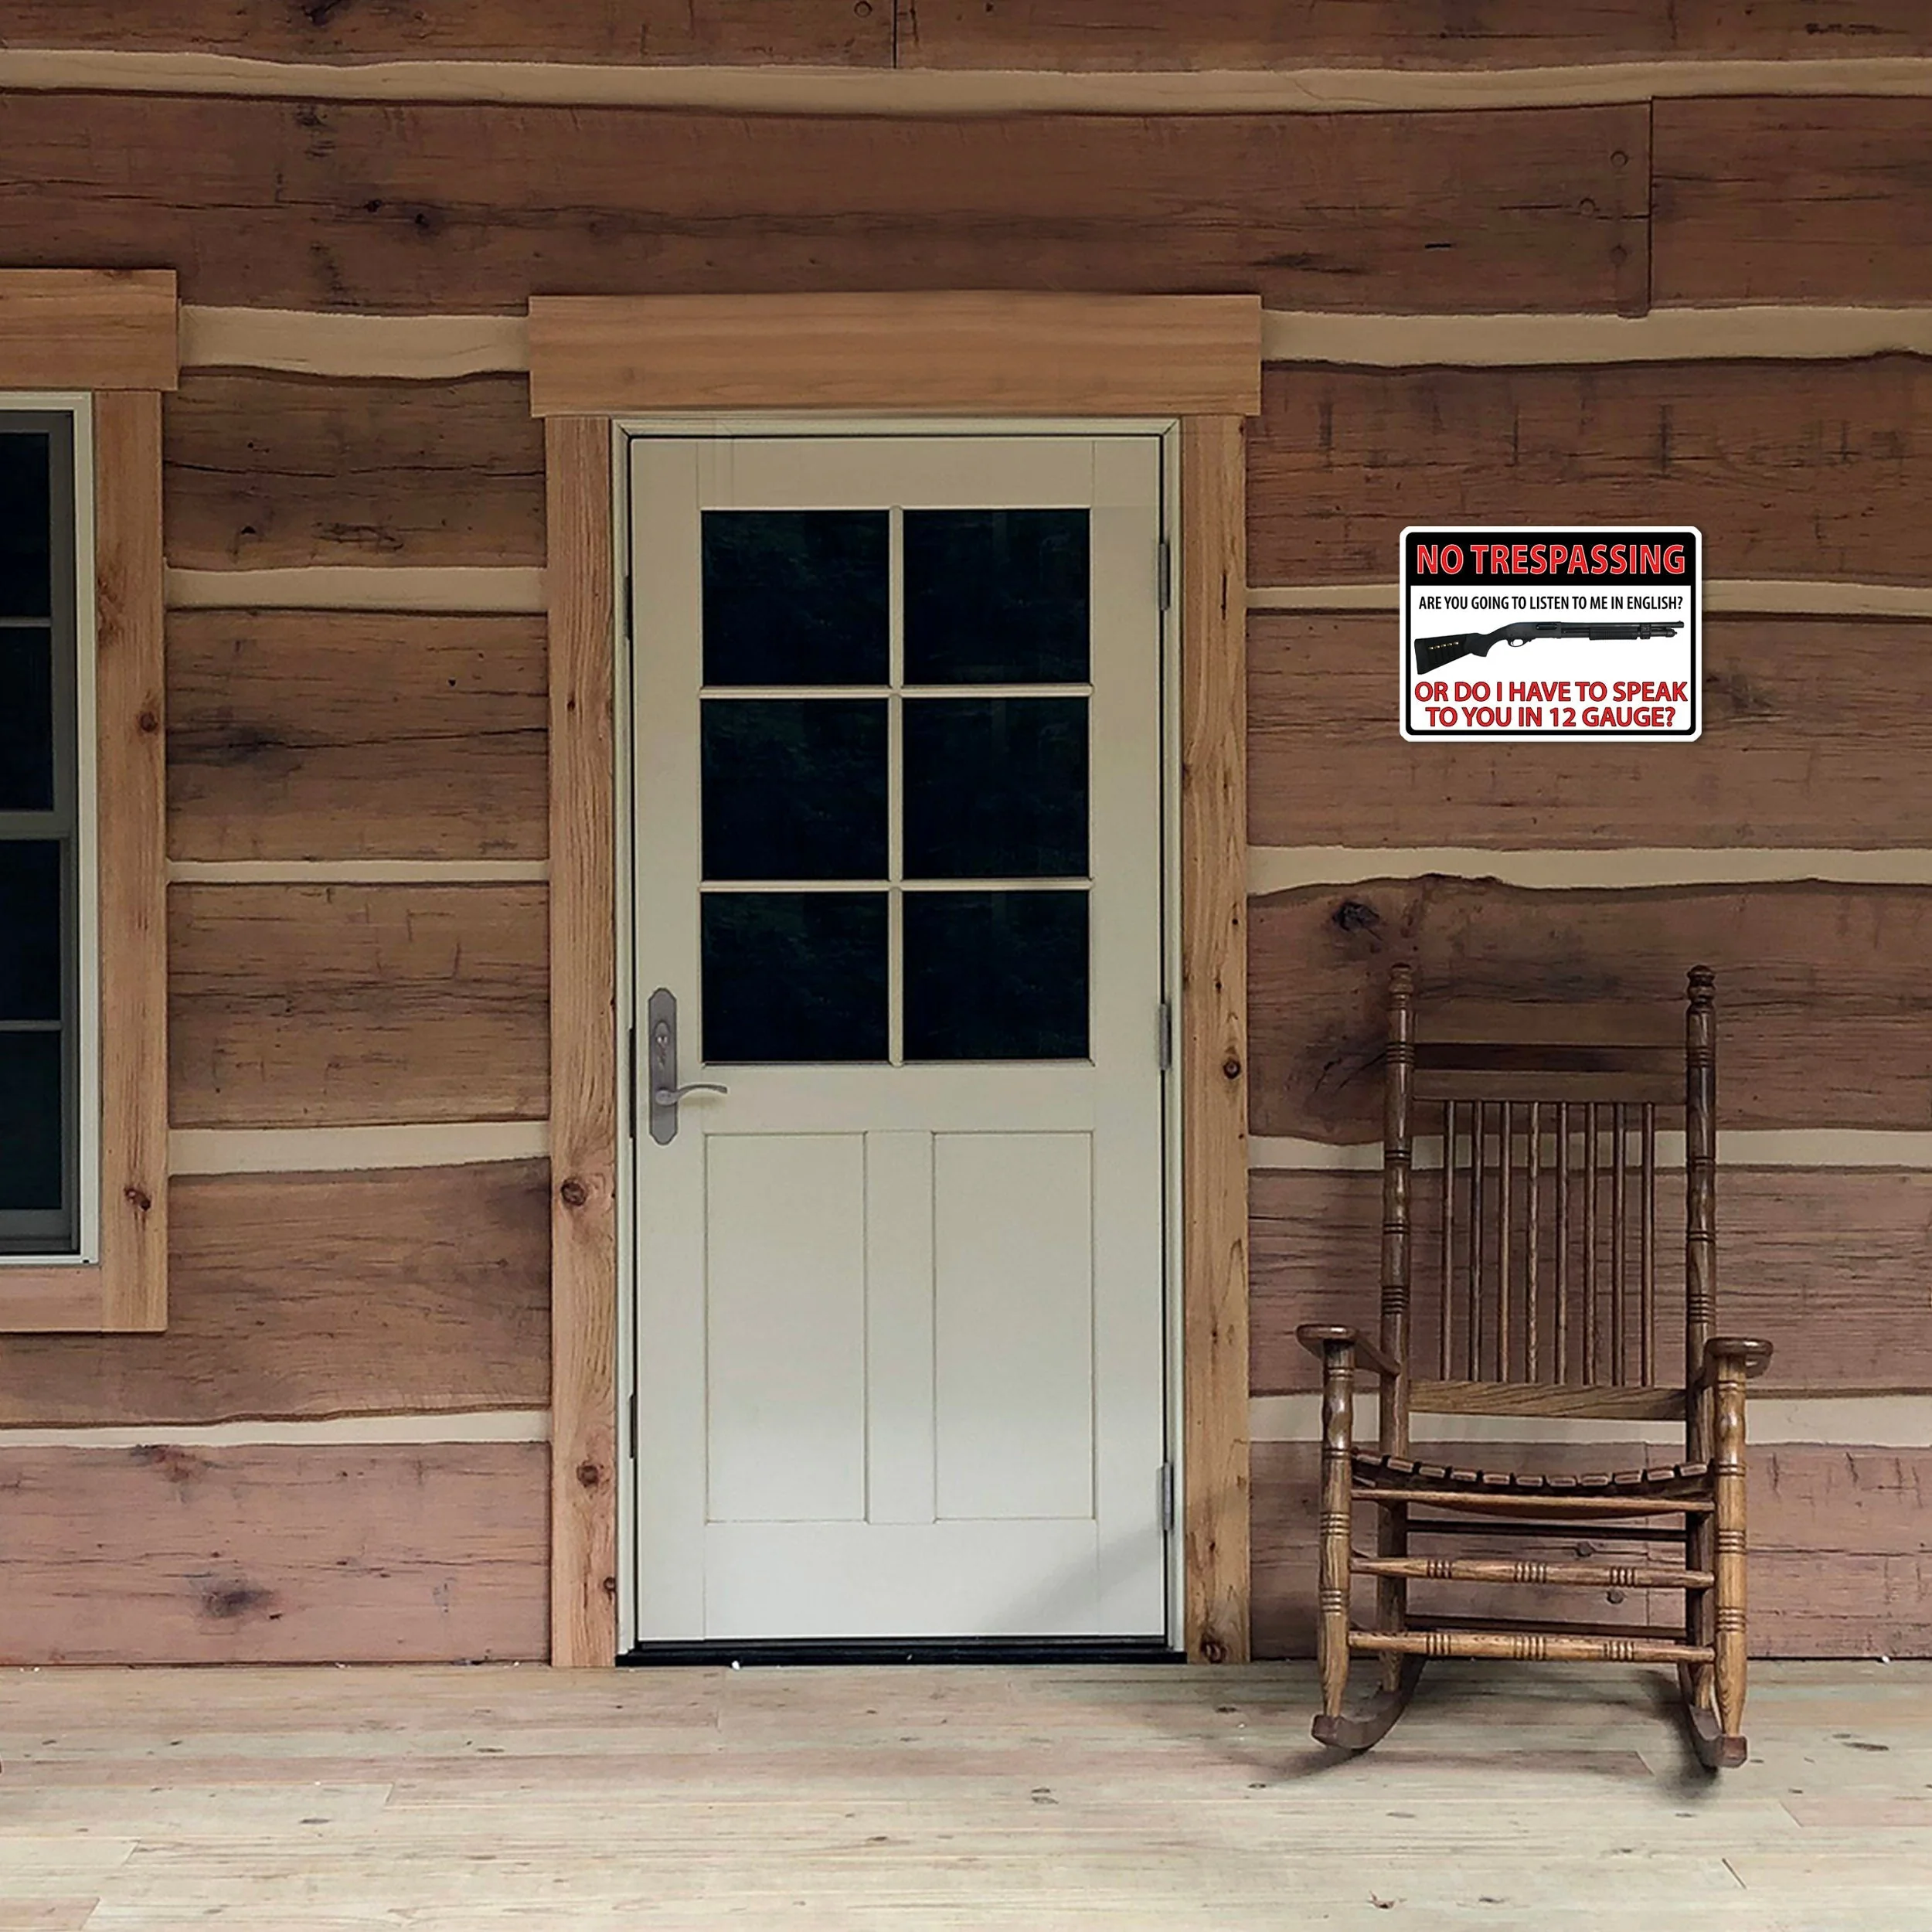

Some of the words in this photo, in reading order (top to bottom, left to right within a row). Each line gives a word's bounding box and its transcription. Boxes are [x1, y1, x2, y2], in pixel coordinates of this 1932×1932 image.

[1417, 544, 1464, 574] NO
[1471, 544, 1685, 574] TRESPASSING
[1419, 597, 1441, 609] ARE
[1444, 597, 1468, 609] YOU
[1471, 597, 1509, 609] GOING
[1512, 597, 1526, 609] TO
[1530, 597, 1569, 609] LISTEN
[1572, 597, 1587, 609] TO
[1590, 597, 1607, 609] ME
[1611, 597, 1623, 609] IN
[1628, 597, 1682, 609] ENGLISH?
[1415, 682, 1448, 702] OR
[1455, 682, 1490, 702] DO
[1497, 682, 1502, 702] I
[1509, 682, 1571, 702] HAVE
[1575, 682, 1607, 702] TO
[1613, 682, 1688, 702] SPEAK
[1425, 707, 1458, 726] TO
[1461, 707, 1512, 726] YOU
[1519, 707, 1542, 726] IN
[1550, 707, 1576, 726] 12
[1582, 706, 1675, 727] GAUGE?
